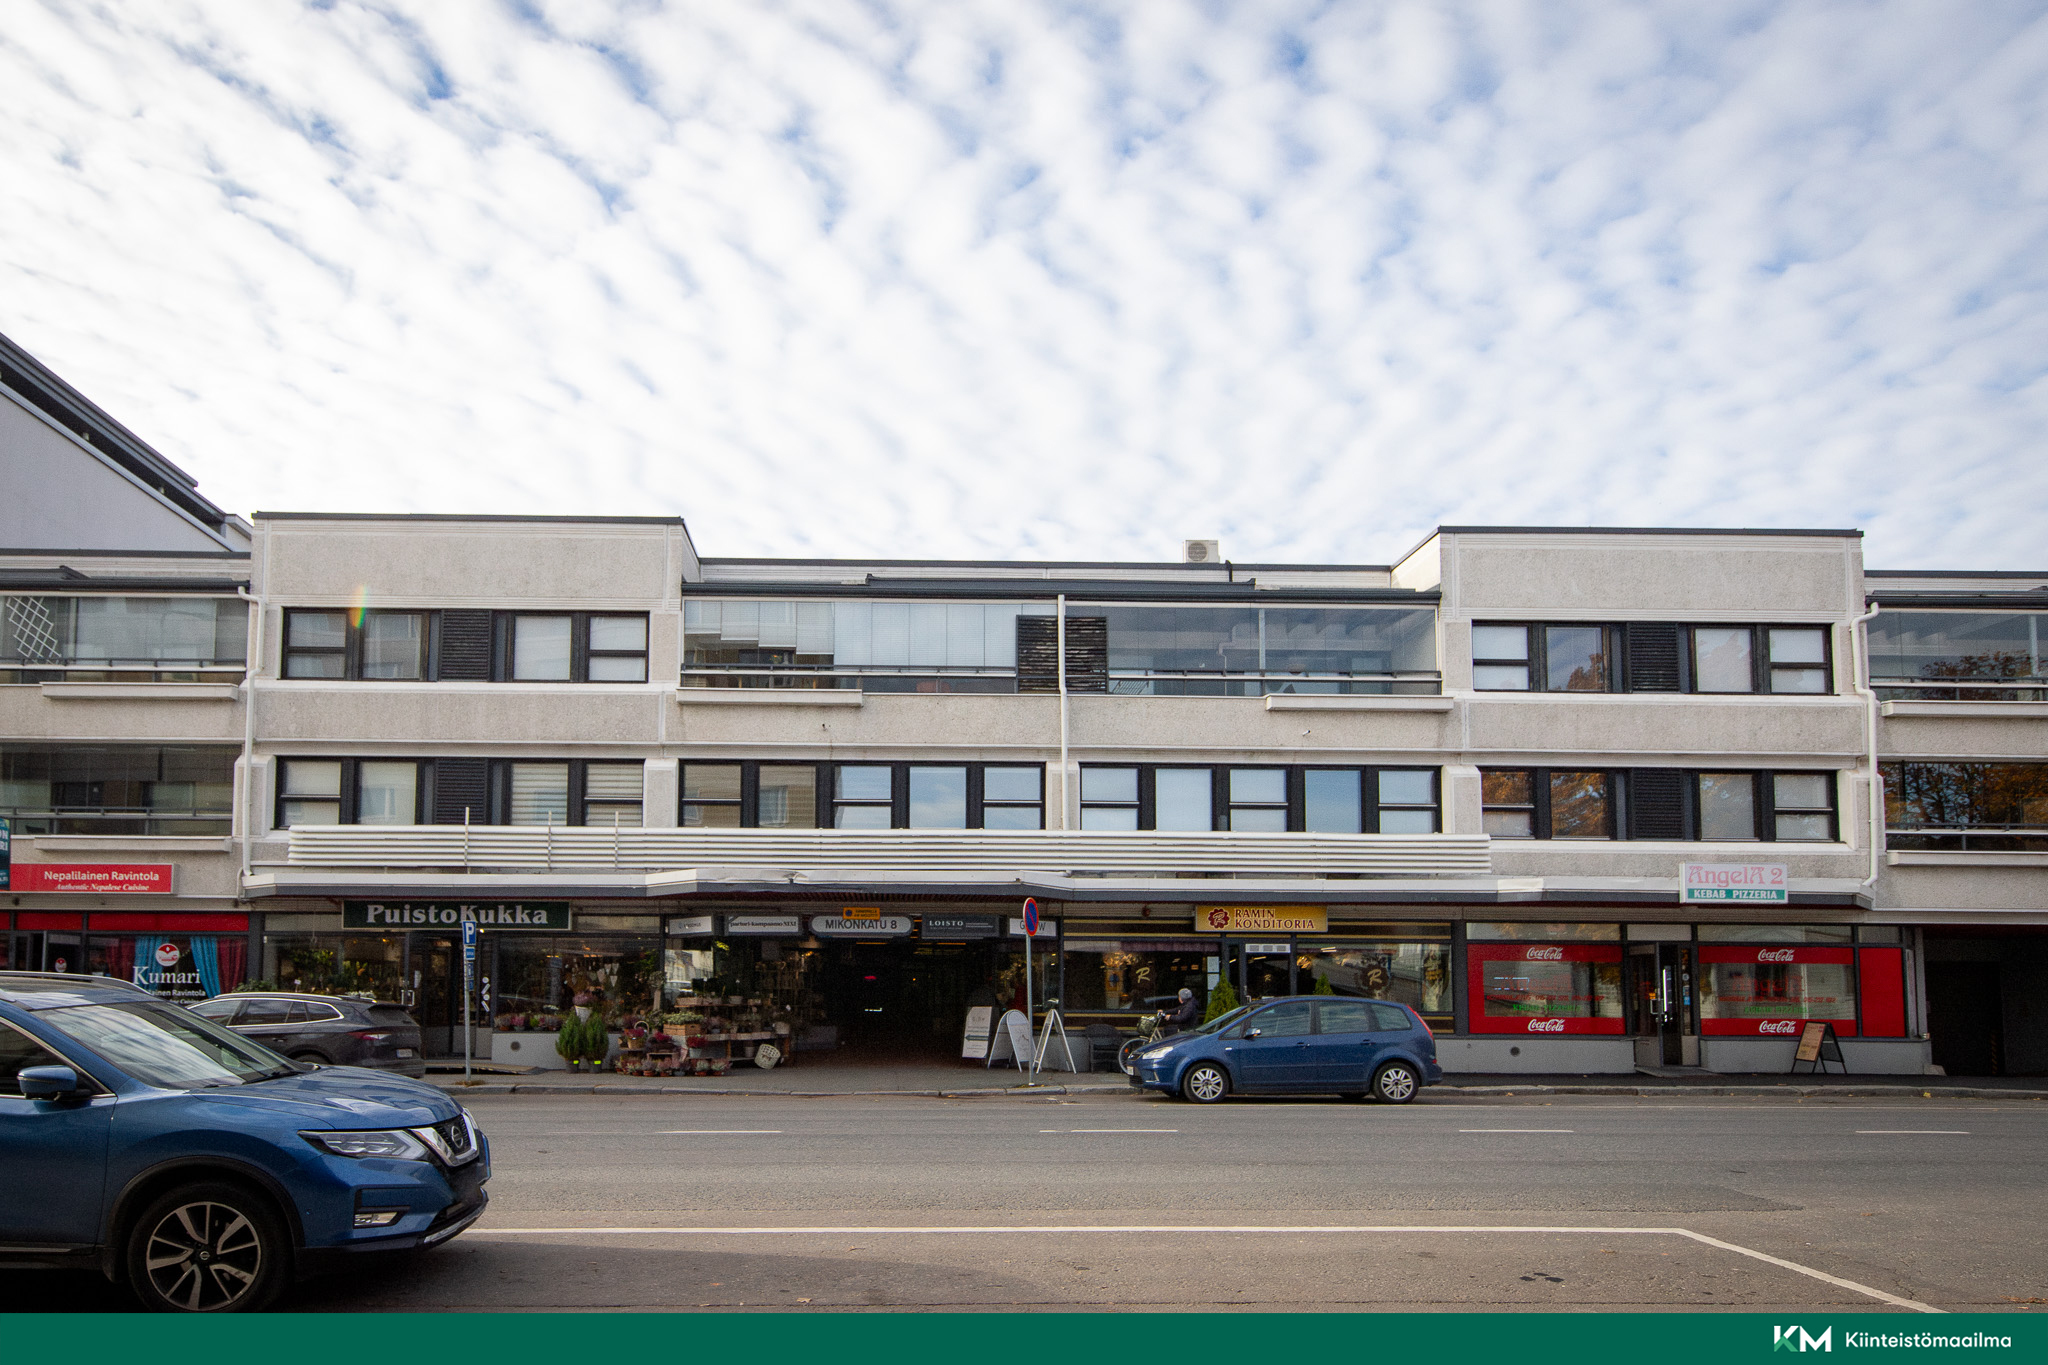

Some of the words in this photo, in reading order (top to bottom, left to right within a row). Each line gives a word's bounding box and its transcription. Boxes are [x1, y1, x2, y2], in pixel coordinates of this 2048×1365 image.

[44, 871, 109, 882] Nepalilainen
[111, 871, 159, 881] Ravintola
[1770, 867, 1784, 885] 2
[90, 884, 122, 892] Nepalese
[1693, 889, 1726, 899] KEBAB
[1732, 890, 1778, 900] PIZZERIA
[366, 904, 548, 924] PuistoKukka
[1234, 908, 1275, 918] RAMIN
[825, 919, 887, 929] MIKONKATU
[890, 920, 897, 929] 8
[1234, 918, 1315, 929] KONDITORIA
[465, 922, 475, 944] P
[133, 966, 201, 985] Kumari
[172, 989, 206, 997] Ravintola
